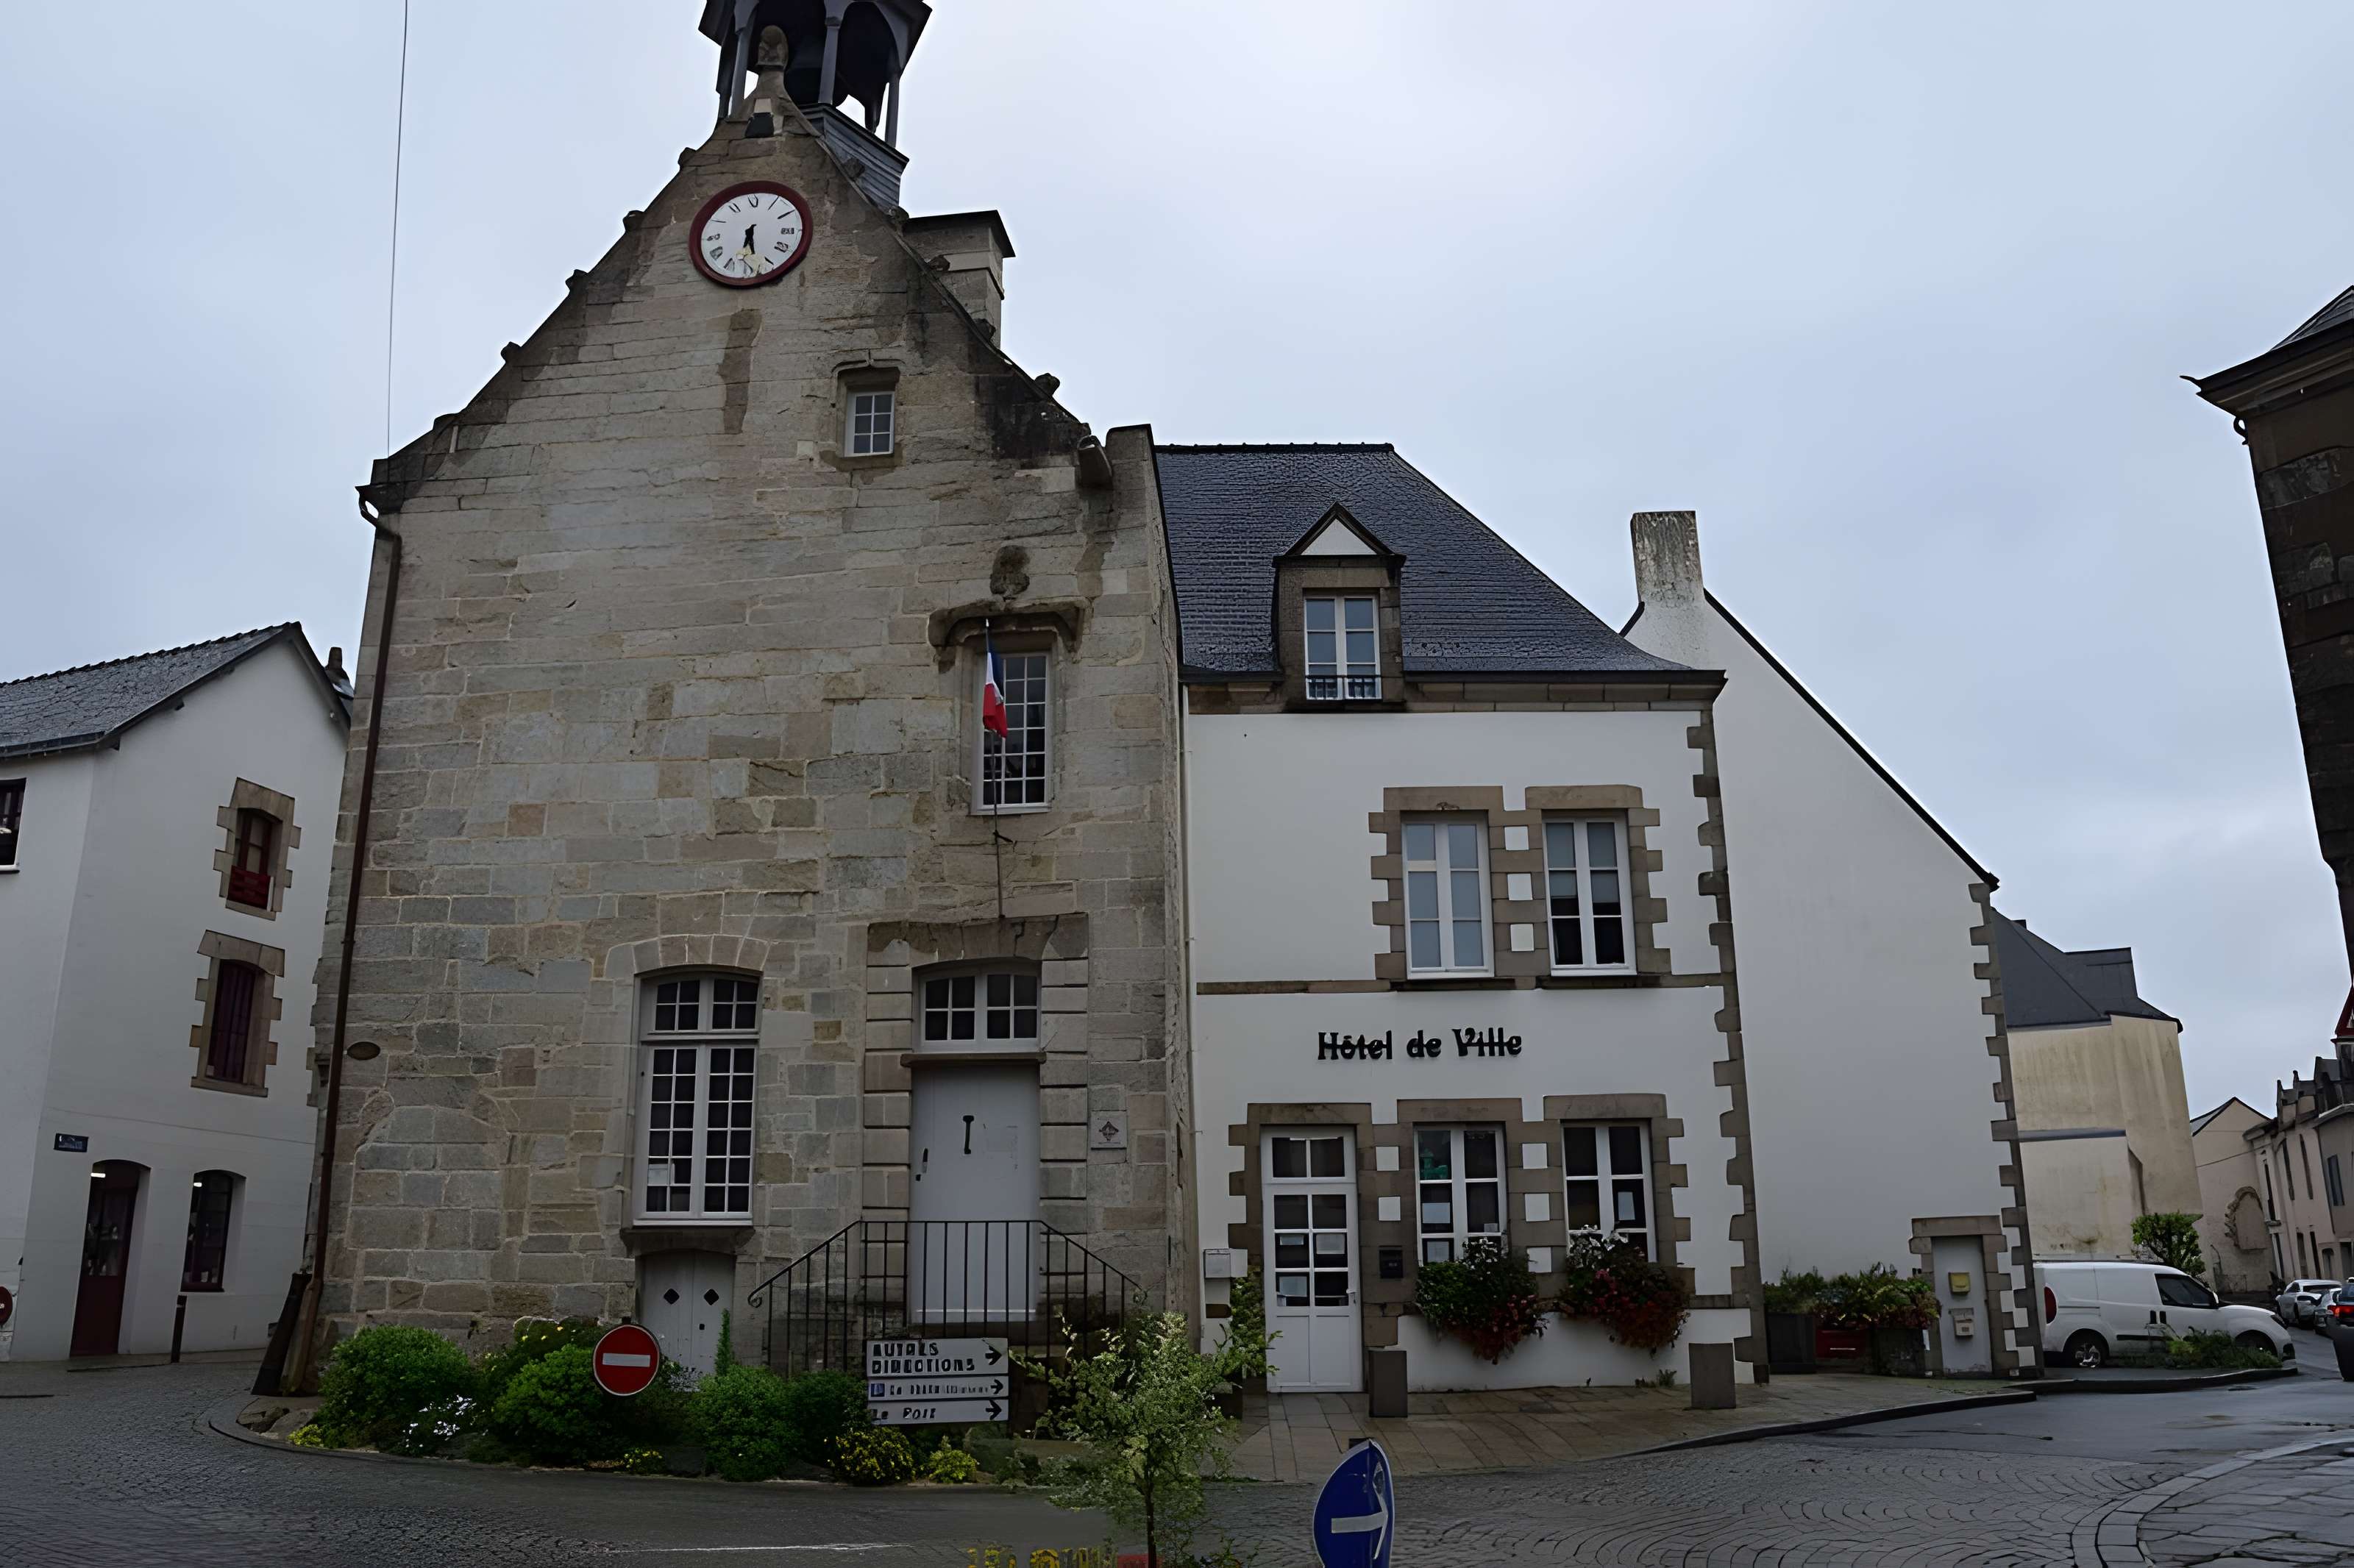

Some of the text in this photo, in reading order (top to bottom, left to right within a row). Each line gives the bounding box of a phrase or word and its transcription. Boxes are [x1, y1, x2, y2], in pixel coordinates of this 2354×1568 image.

[1318, 1027, 1523, 1061] Hôtel de Ville
